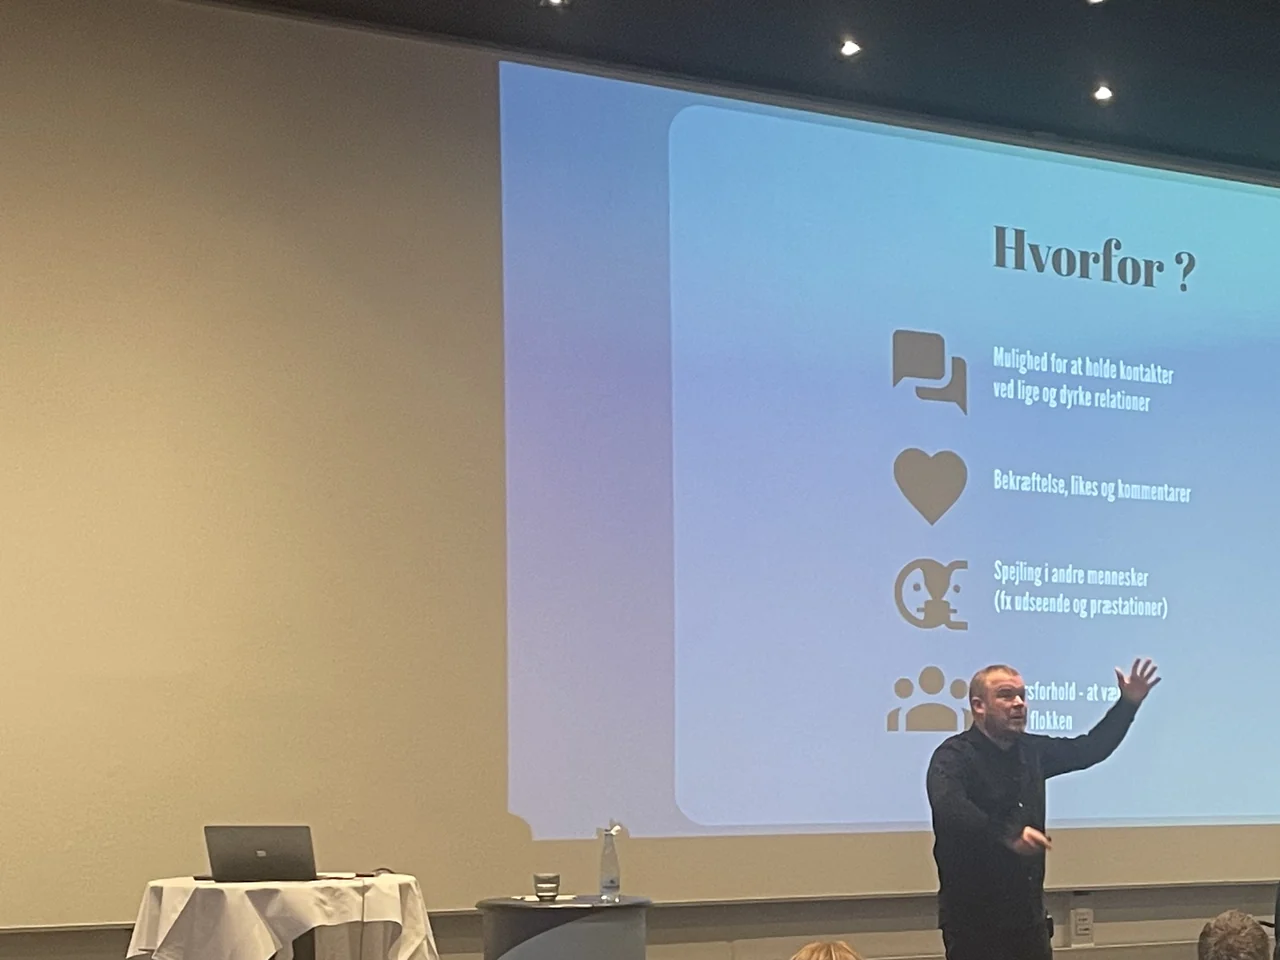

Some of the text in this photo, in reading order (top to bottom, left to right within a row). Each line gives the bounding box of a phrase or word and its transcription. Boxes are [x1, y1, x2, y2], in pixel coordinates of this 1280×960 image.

[993, 225, 1196, 292] Hvorfor ?
[993, 346, 1174, 385] Mulighed for at holde kontakter
[993, 379, 1151, 412] ved lige og dyrke relationer
[994, 469, 1192, 503] Bekræftelse, likes og kommentarer
[994, 560, 1149, 587] Spejling i andre mennesker
[994, 589, 1168, 619] (fx udseende og præstationer)
[1086, 683, 1099, 701] at
[1030, 710, 1073, 730] flokken
